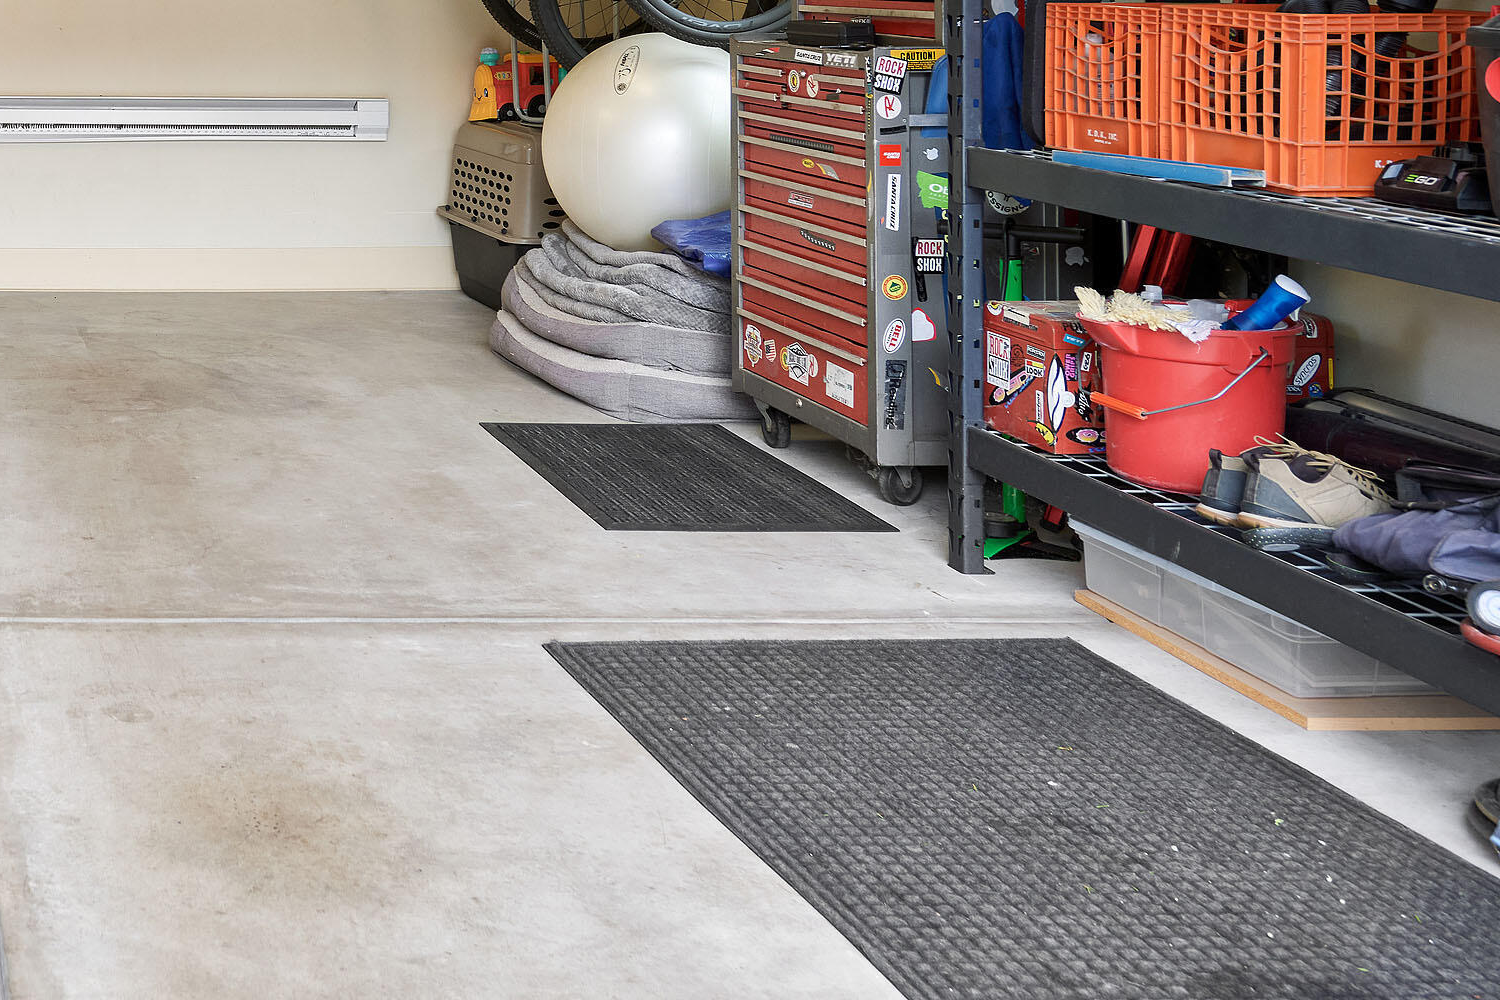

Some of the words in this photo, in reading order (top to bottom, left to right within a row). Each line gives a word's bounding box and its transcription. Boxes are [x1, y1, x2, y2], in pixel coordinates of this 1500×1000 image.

[826, 53, 857, 63] YETI
[900, 51, 936, 60] CAUTION!
[878, 58, 904, 75] ROCK
[874, 74, 901, 93] SHOX
[1404, 174, 1438, 185] EGO
[917, 241, 942, 254] ROCK
[917, 258, 943, 272] SHOX
[888, 325, 902, 348] BELL
[1026, 366, 1043, 377] LOOK
